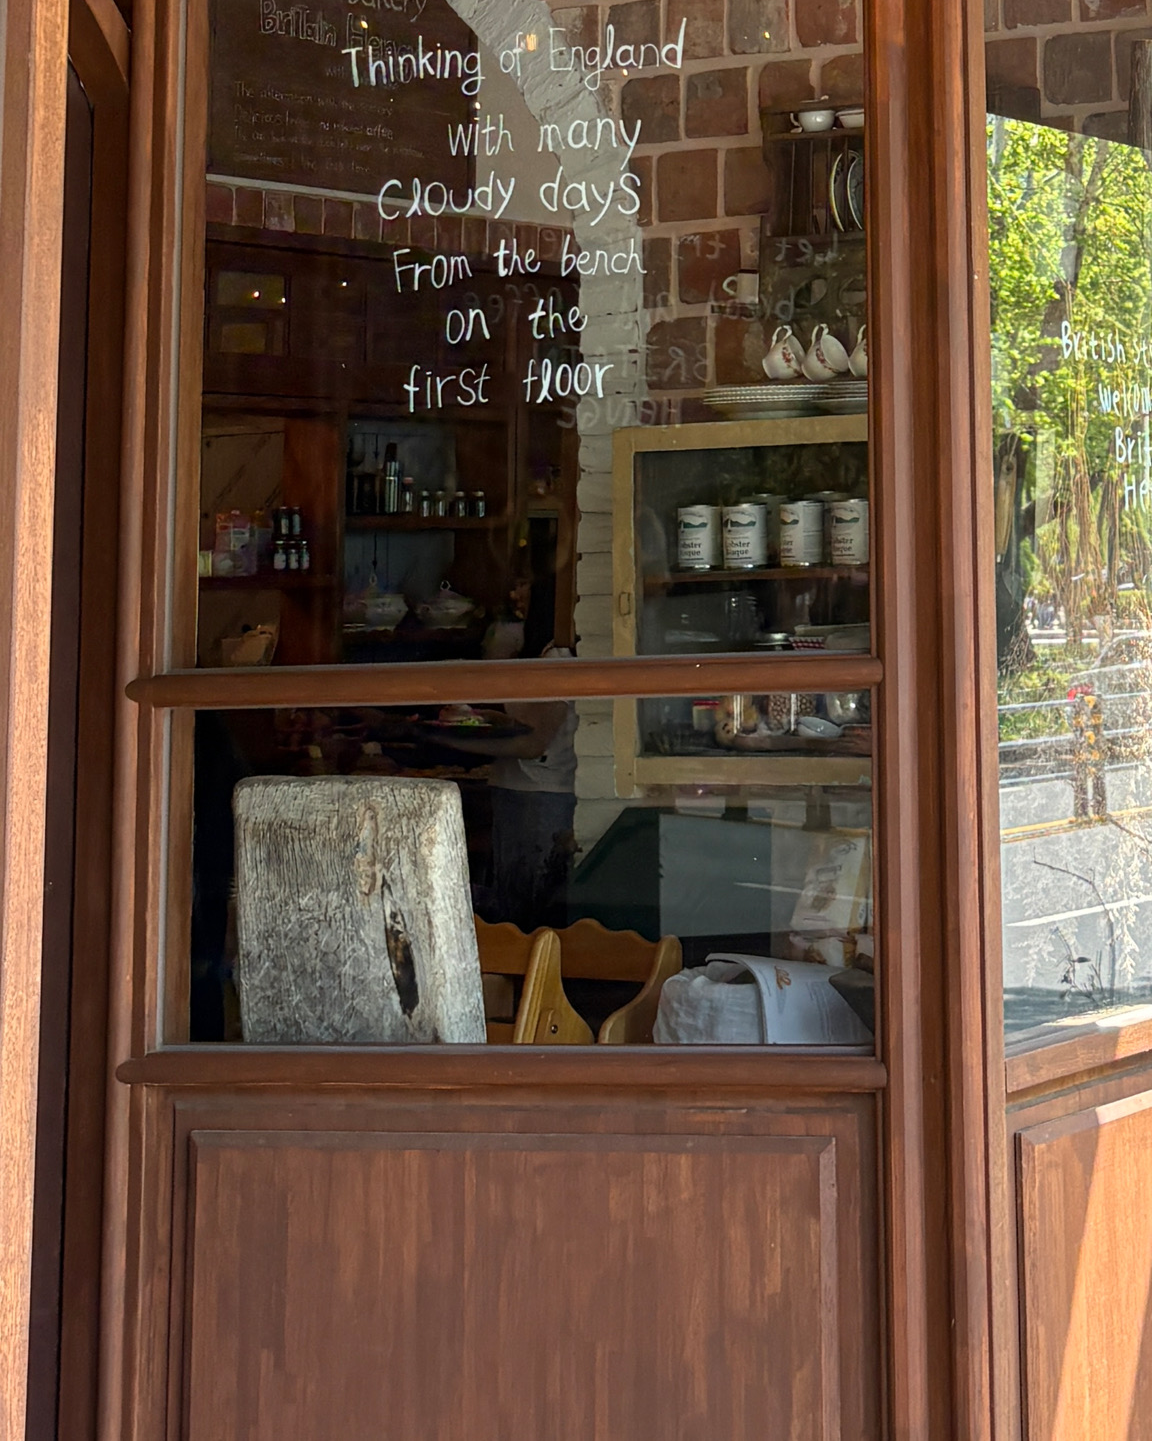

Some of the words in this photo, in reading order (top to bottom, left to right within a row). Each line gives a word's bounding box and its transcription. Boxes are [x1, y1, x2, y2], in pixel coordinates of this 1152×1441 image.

[340, 35, 485, 96] Thinking
[500, 33, 527, 76] of
[550, 17, 687, 91] England
[447, 114, 513, 157] with
[537, 116, 643, 170] many
[378, 168, 515, 222] Cloudy
[539, 167, 641, 226] days
[392, 249, 472, 293] From
[494, 241, 542, 277] the
[560, 233, 648, 276] bench
[445, 306, 491, 345] on
[529, 284, 589, 339] the
[1061, 321, 1127, 363] British
[403, 365, 491, 414] first
[522, 361, 616, 405] floor
